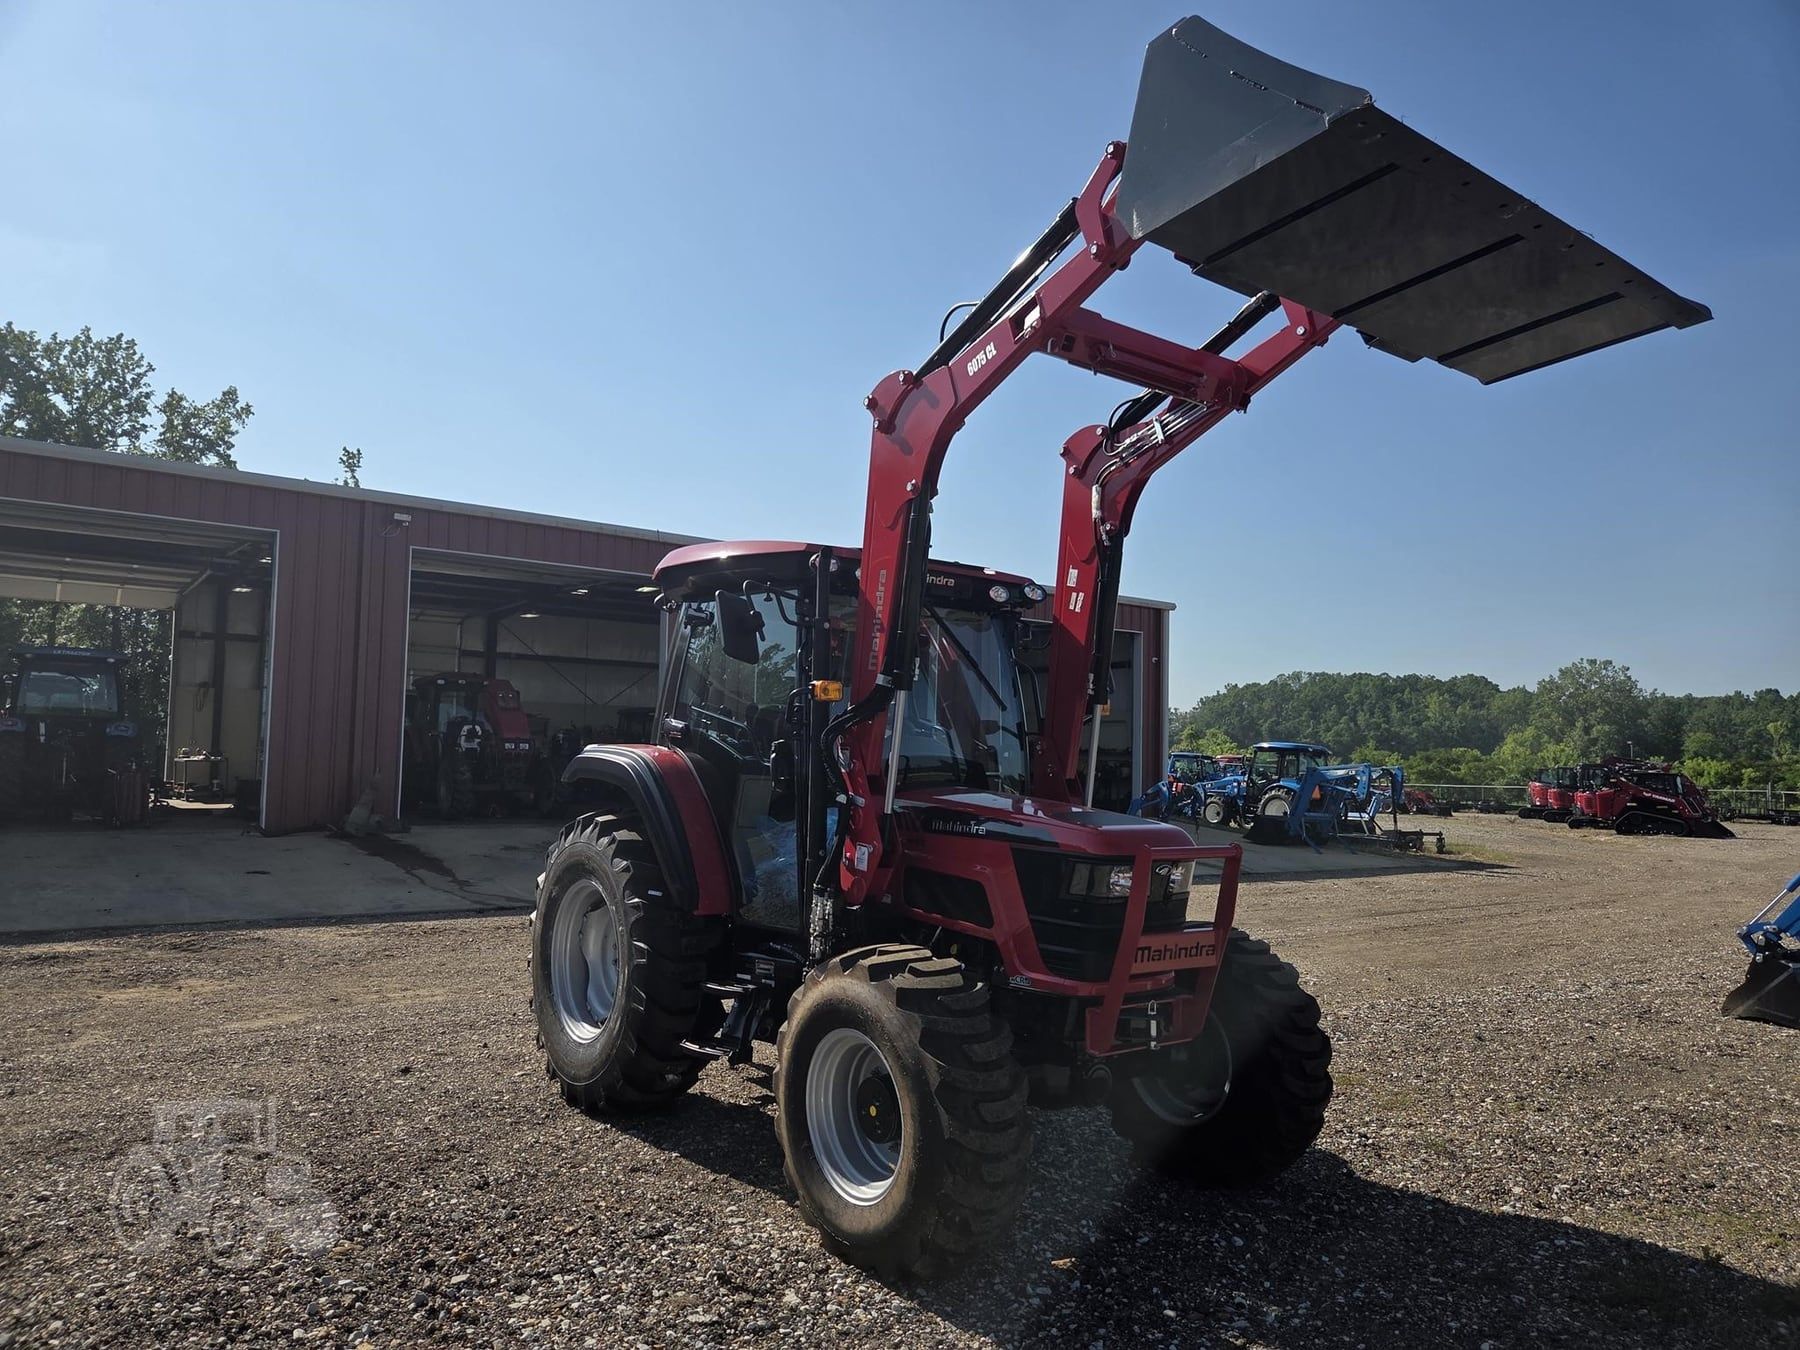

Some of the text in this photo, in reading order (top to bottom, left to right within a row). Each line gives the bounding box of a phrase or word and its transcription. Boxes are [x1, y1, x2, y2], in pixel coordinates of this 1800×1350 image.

[967, 350, 987, 377] 6075
[926, 573, 955, 587] indra
[1134, 941, 1216, 964] Mahindra
